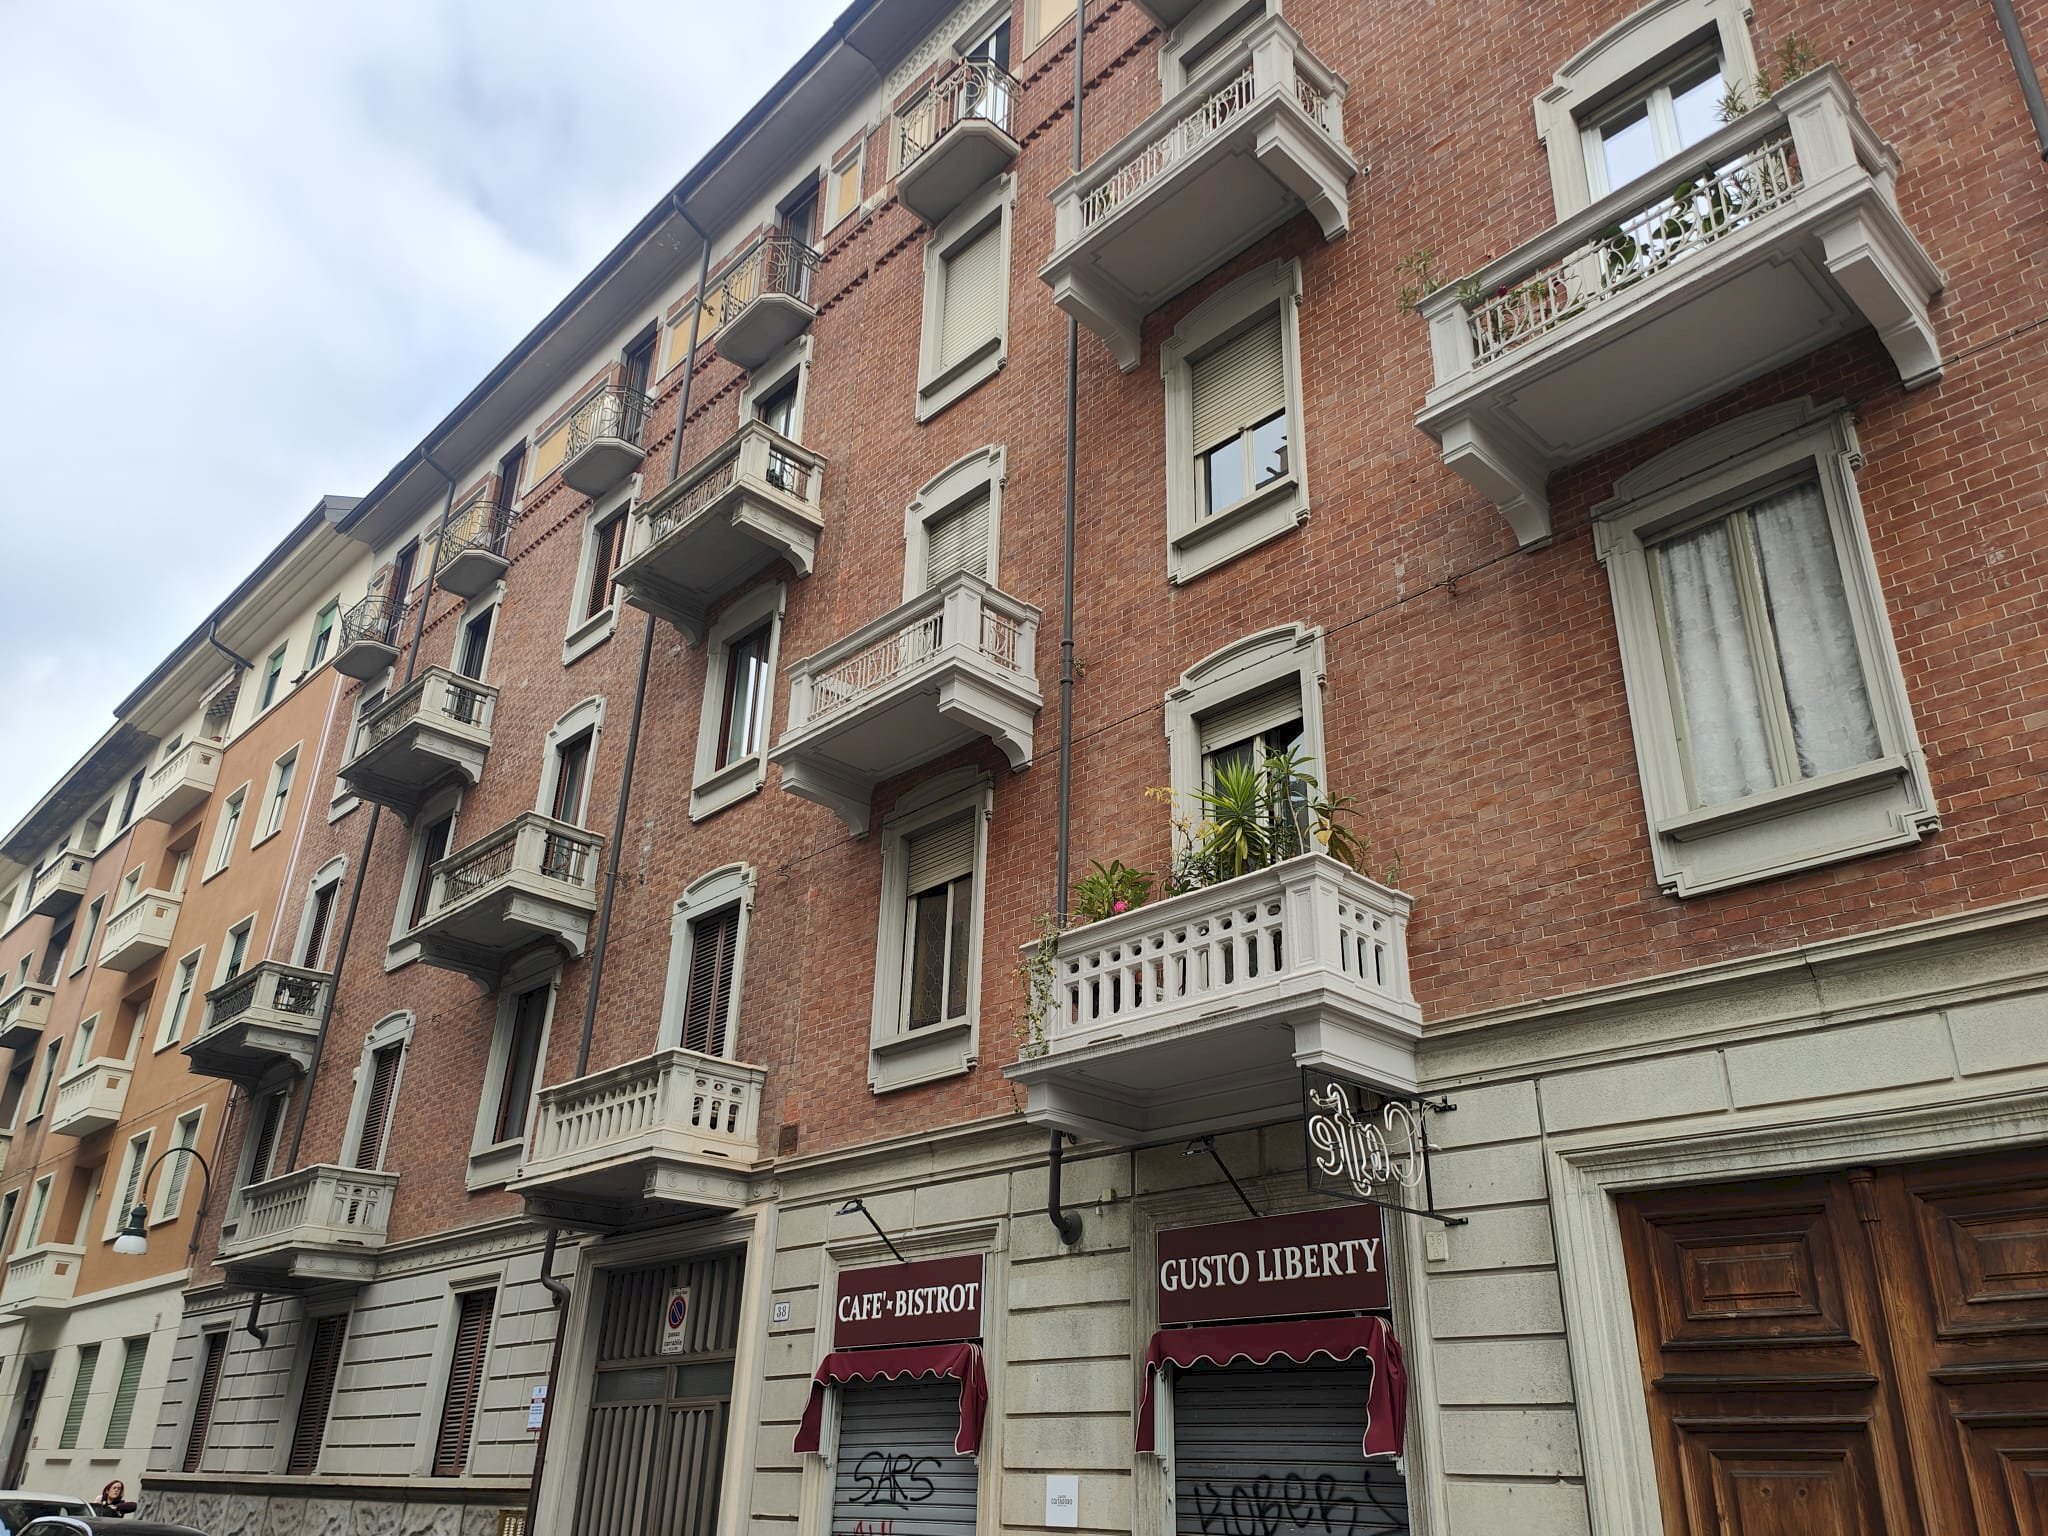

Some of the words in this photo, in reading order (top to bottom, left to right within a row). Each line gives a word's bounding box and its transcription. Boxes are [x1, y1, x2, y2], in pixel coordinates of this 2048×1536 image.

[1160, 1251, 1250, 1292] GUSTO
[1256, 1237, 1380, 1282] LIBERTY
[838, 1290, 887, 1322] CAFE'
[894, 1282, 979, 1317] BISTROT
[849, 1451, 942, 1502] SARS
